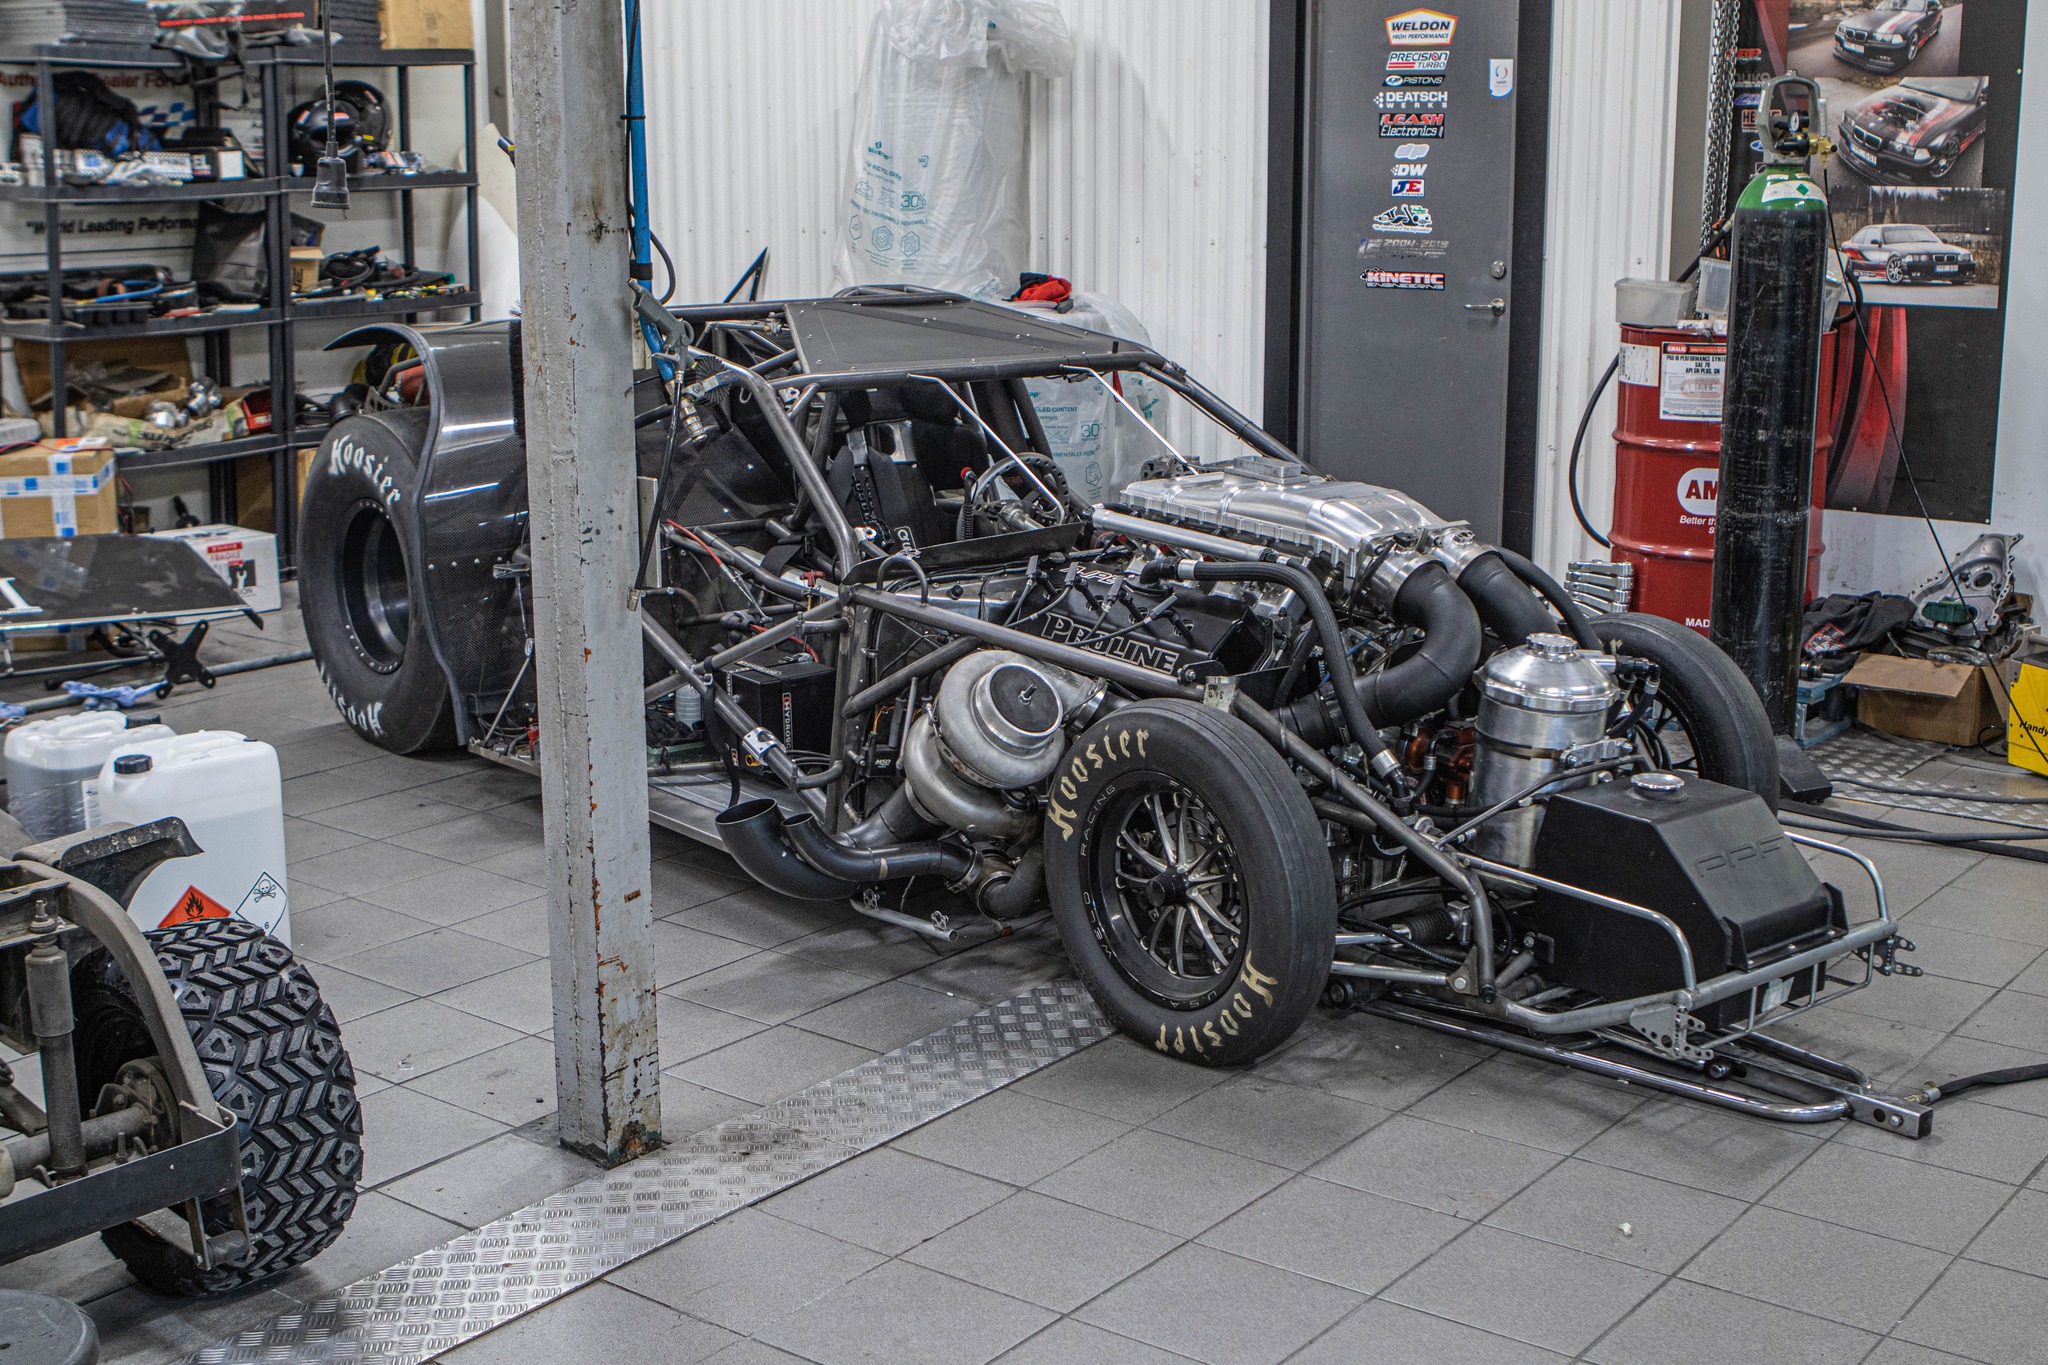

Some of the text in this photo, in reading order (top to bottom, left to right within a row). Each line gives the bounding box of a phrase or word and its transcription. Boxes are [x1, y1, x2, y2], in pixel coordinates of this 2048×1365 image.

[1392, 21, 1450, 31] WELDON
[1390, 52, 1448, 61] PRECISION
[1418, 61, 1445, 69] TURBO
[1403, 76, 1443, 84] PISTONS
[1386, 91, 1448, 102] DEATSCH
[1383, 113, 1444, 125] LEASH
[1381, 126, 1437, 136] Electronics
[1397, 164, 1427, 176] DW
[1393, 180, 1422, 194] JE
[77, 219, 134, 234] Leading
[138, 216, 199, 233] Performa
[1366, 271, 1444, 284] KINETIC
[328, 433, 401, 506] Hoosier
[1685, 479, 1719, 500] AM
[1679, 515, 1716, 526] Better th
[210, 550, 241, 561] FRAGILE
[1685, 617, 1710, 628] MAD
[1047, 723, 1149, 842] Hoosier
[1079, 784, 1117, 857] RACING
[264, 921, 270, 930] 6
[1083, 891, 1112, 960] WELD
[1155, 949, 1279, 1063] Hoosier
